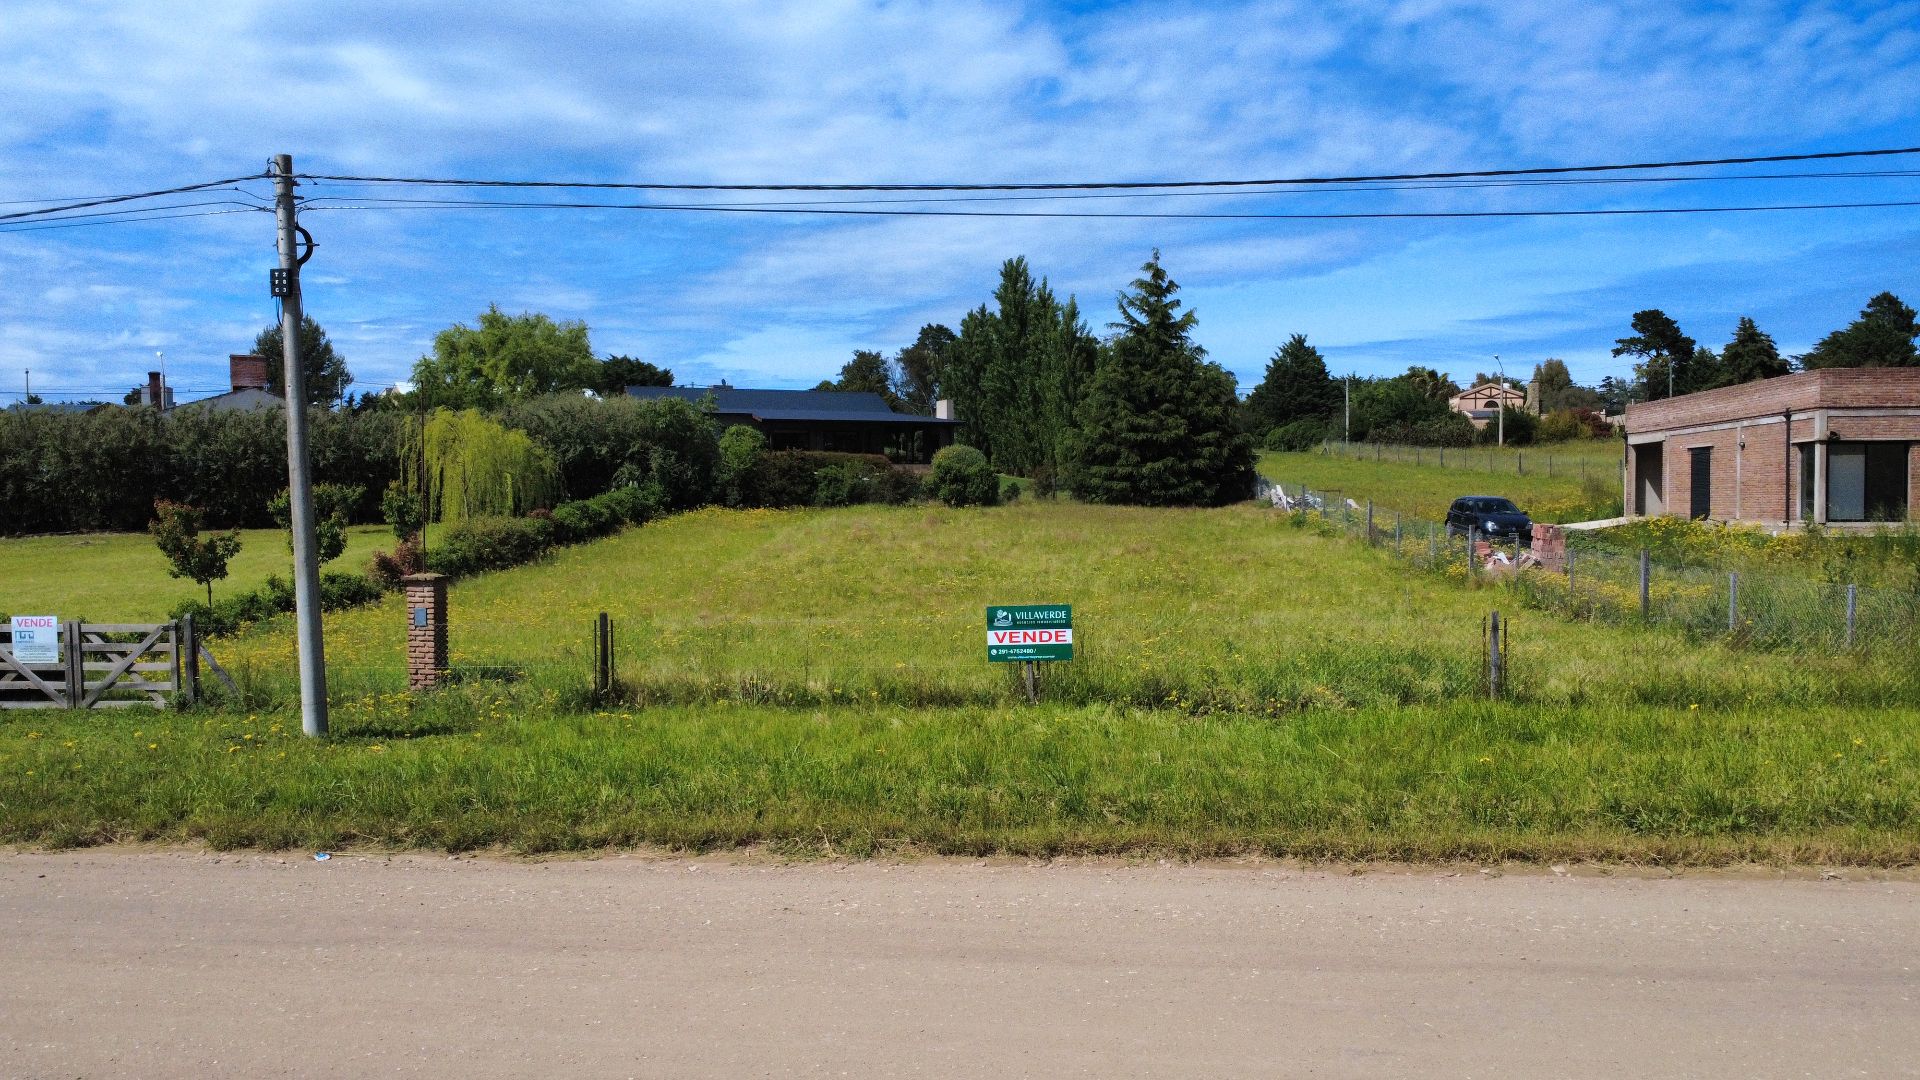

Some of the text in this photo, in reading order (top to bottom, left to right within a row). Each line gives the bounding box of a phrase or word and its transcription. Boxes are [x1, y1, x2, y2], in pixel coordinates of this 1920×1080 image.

[1015, 610, 1067, 620] VILLAVERDE
[16, 618, 53, 628] VENDE
[994, 630, 1067, 644] VENDE
